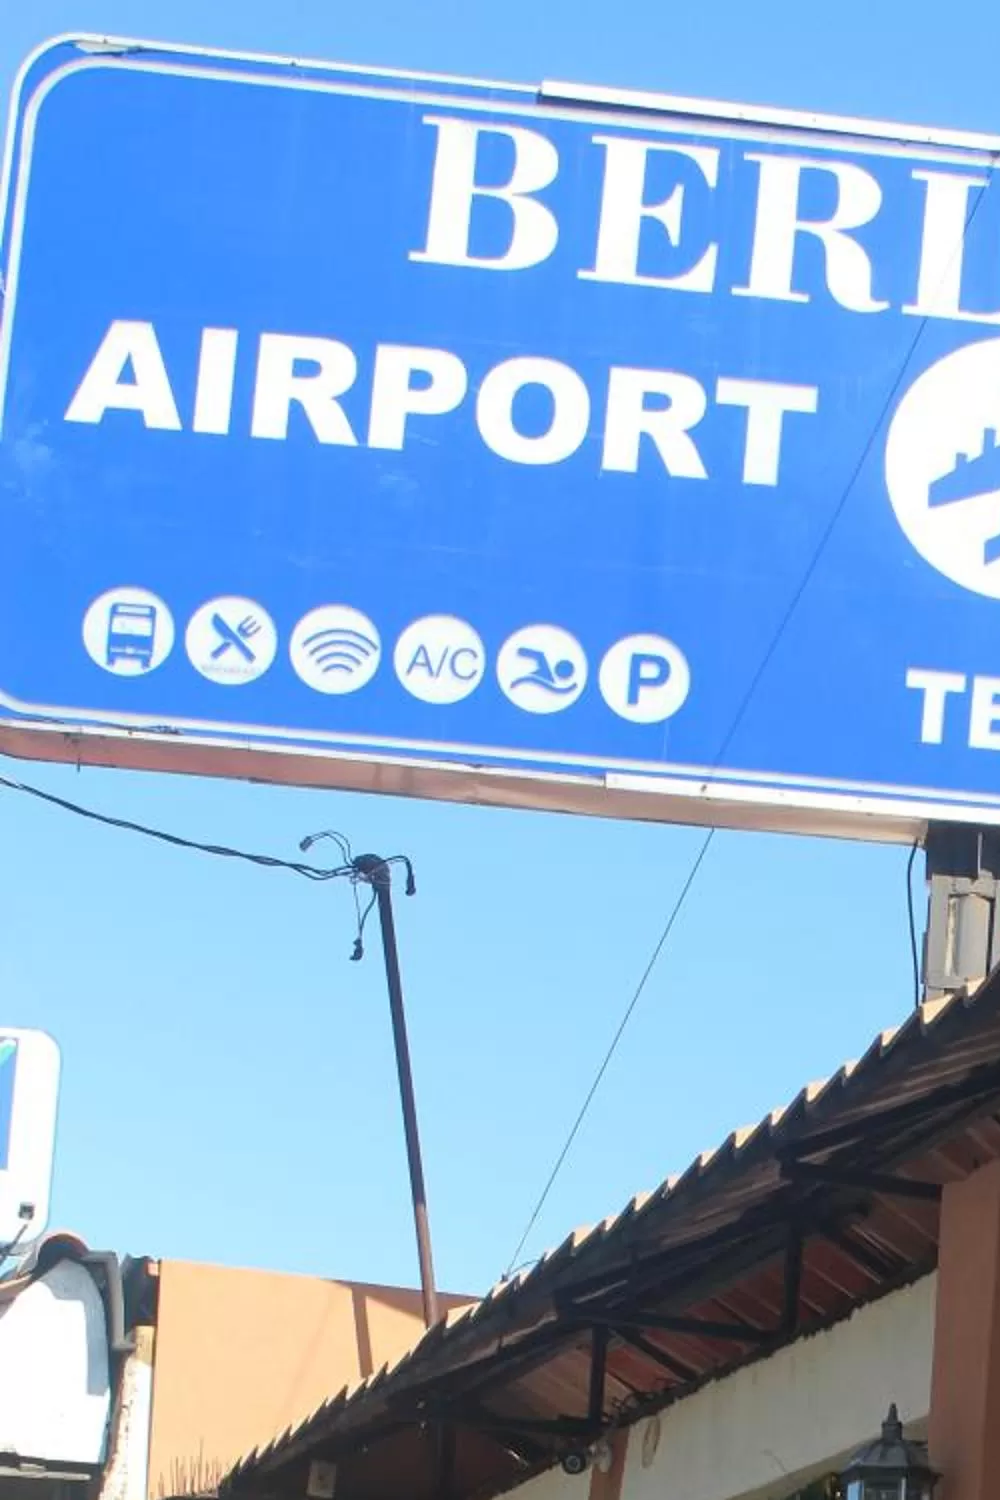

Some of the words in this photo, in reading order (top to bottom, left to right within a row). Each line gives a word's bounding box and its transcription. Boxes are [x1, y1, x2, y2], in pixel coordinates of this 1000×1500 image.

[63, 319, 819, 487] AIRPORT
[406, 643, 479, 681] A/C
[627, 651, 671, 706] P
